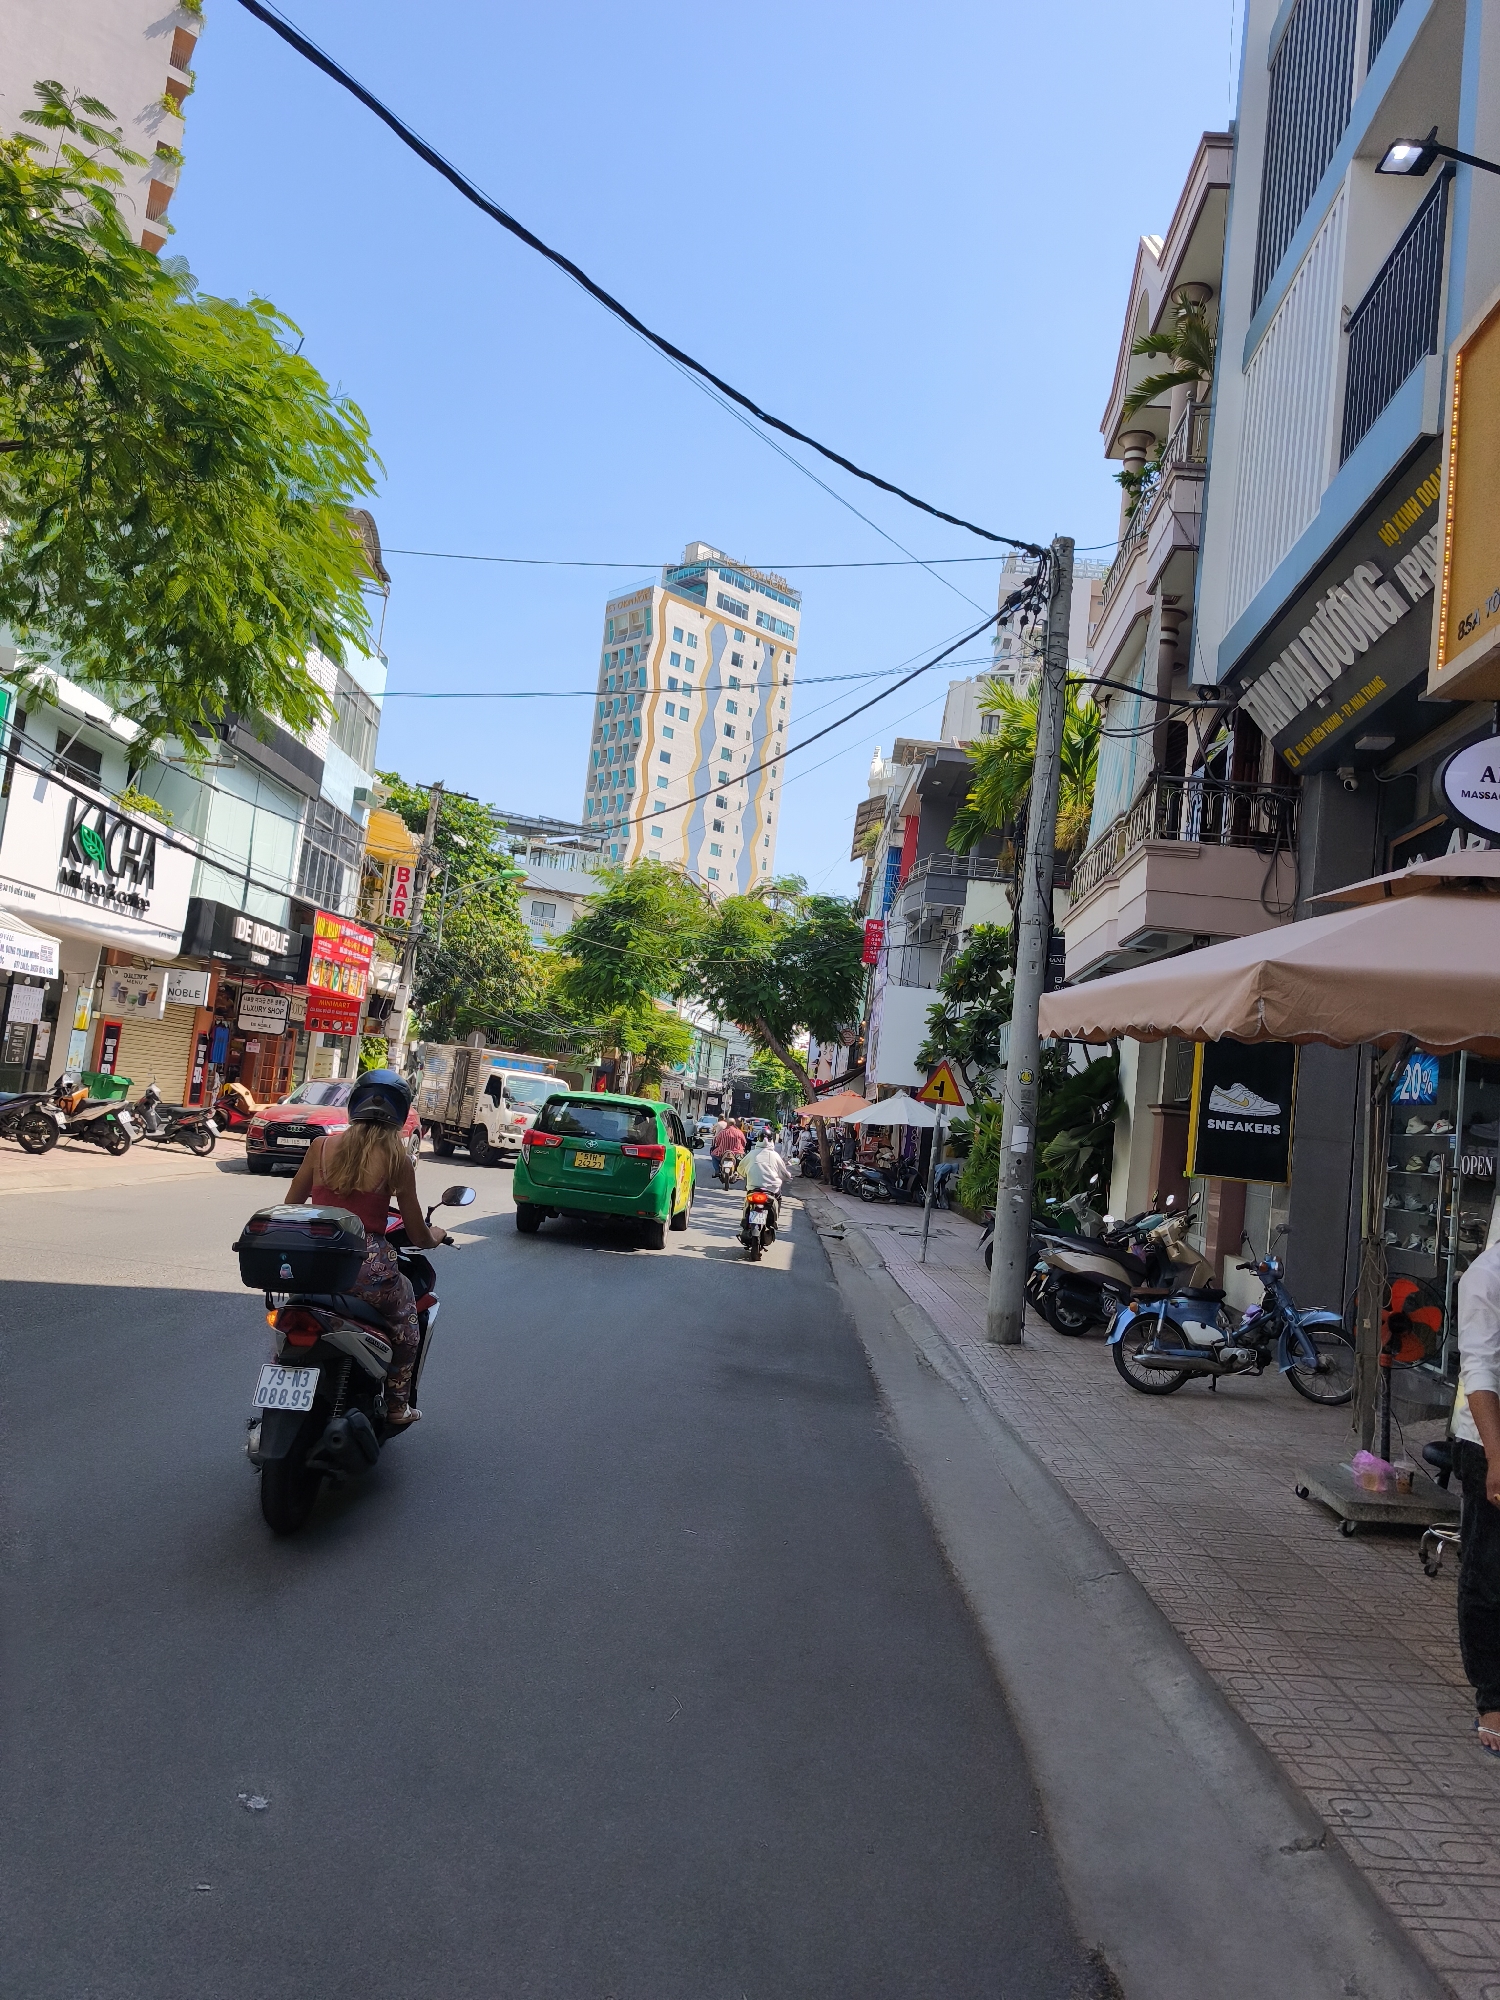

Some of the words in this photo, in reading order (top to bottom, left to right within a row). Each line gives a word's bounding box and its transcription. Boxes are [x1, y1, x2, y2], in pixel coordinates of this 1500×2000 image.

[1378, 519, 1402, 547] HỘ
[1392, 496, 1425, 534] KINH
[1458, 608, 1480, 640] 85A
[1341, 704, 1356, 718] TP.
[1349, 692, 1368, 711] NHA
[1360, 675, 1388, 700] TRANG
[1480, 765, 1500, 784] A
[1461, 789, 1500, 801] MASSA
[393, 866, 411, 918] BAR
[234, 917, 253, 942] DE
[252, 923, 290, 955] NOBLE
[250, 951, 270, 966] PARIS
[167, 987, 201, 998] NOBLE
[243, 1005, 267, 1013] LUXURY
[267, 1007, 285, 1015] SHOP
[1400, 1062, 1433, 1100] 20%
[1207, 1118, 1281, 1135] SNEAKERS
[1461, 1155, 1493, 1176] OPEN
[267, 1368, 311, 1388] 79-N3
[256, 1386, 312, 1408] 088.95
